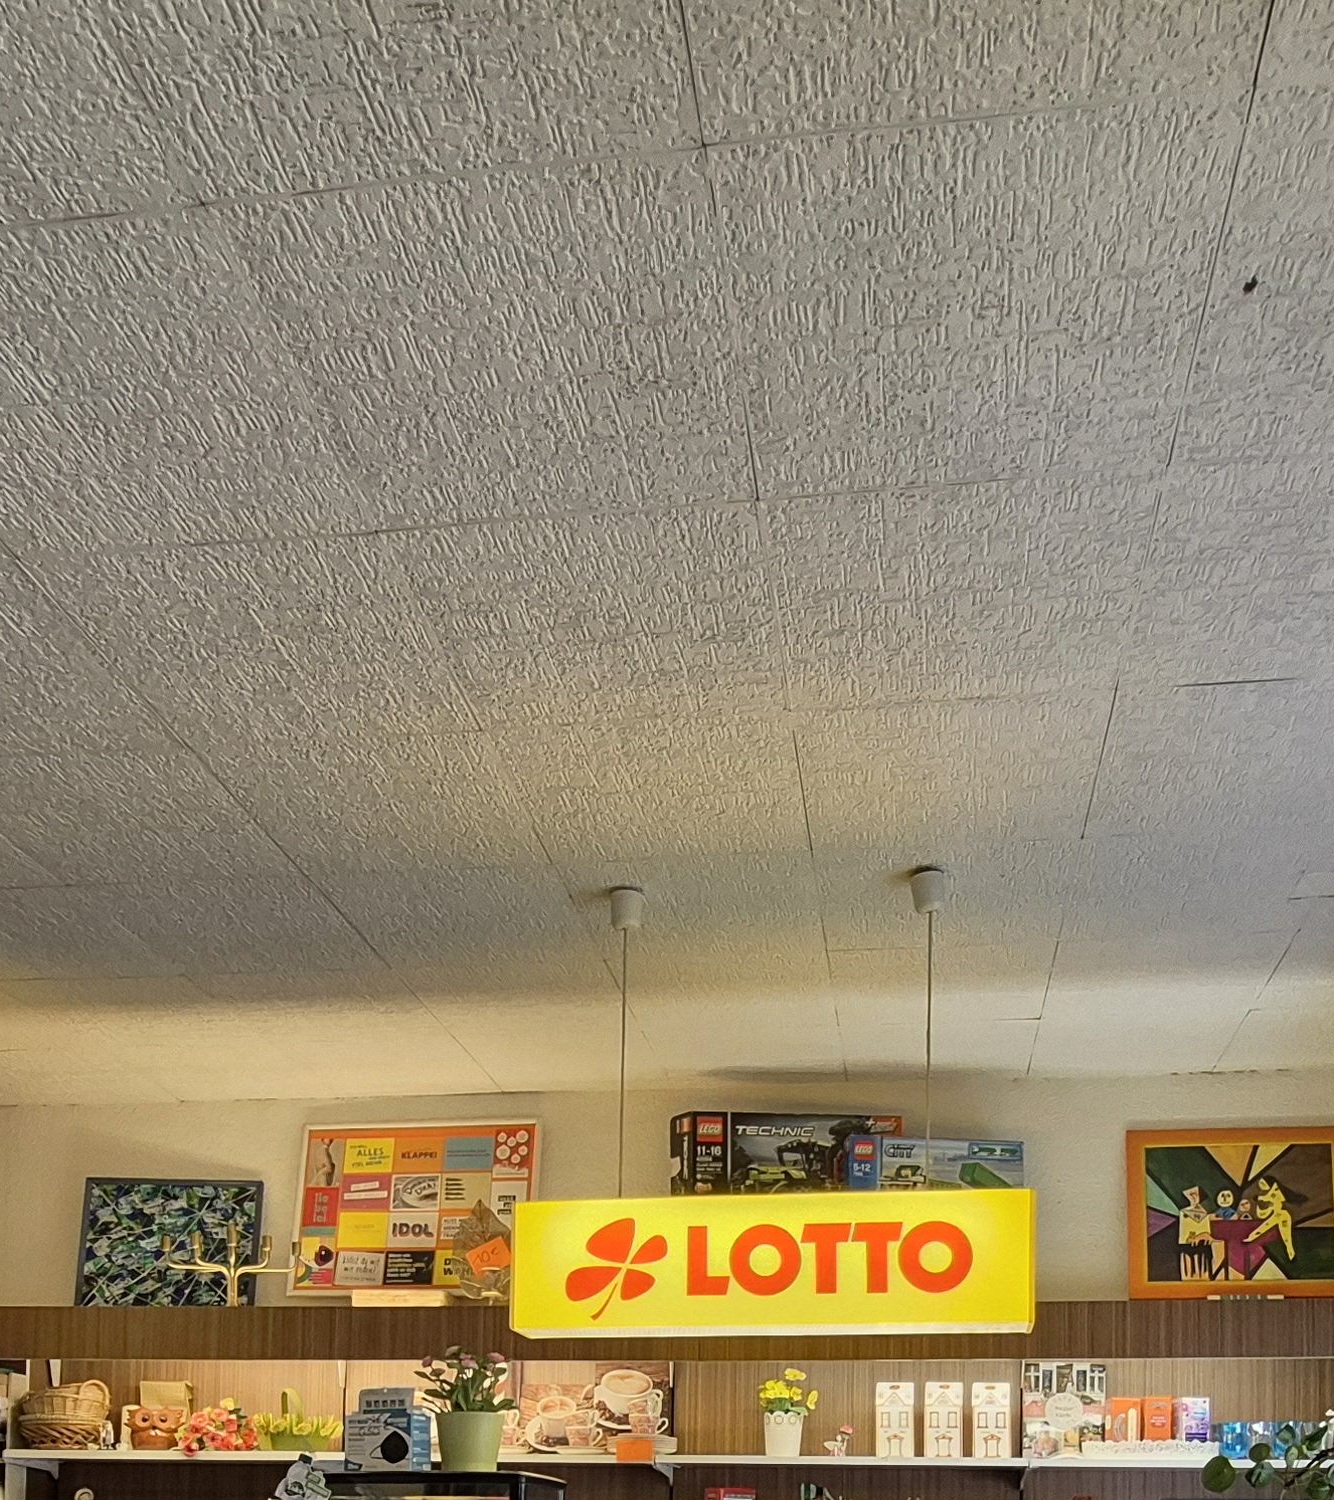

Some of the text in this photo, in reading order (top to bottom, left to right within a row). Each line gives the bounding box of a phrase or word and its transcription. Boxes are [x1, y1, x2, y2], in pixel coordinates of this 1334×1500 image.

[698, 1123, 721, 1135] LEGO
[735, 1124, 815, 1138] TECHNIC
[696, 1145, 721, 1157] 11-16
[855, 1144, 873, 1154] LEGO
[884, 1143, 916, 1159] CITY
[392, 1223, 434, 1238] IDOL
[687, 1221, 973, 1296] LOTTO
